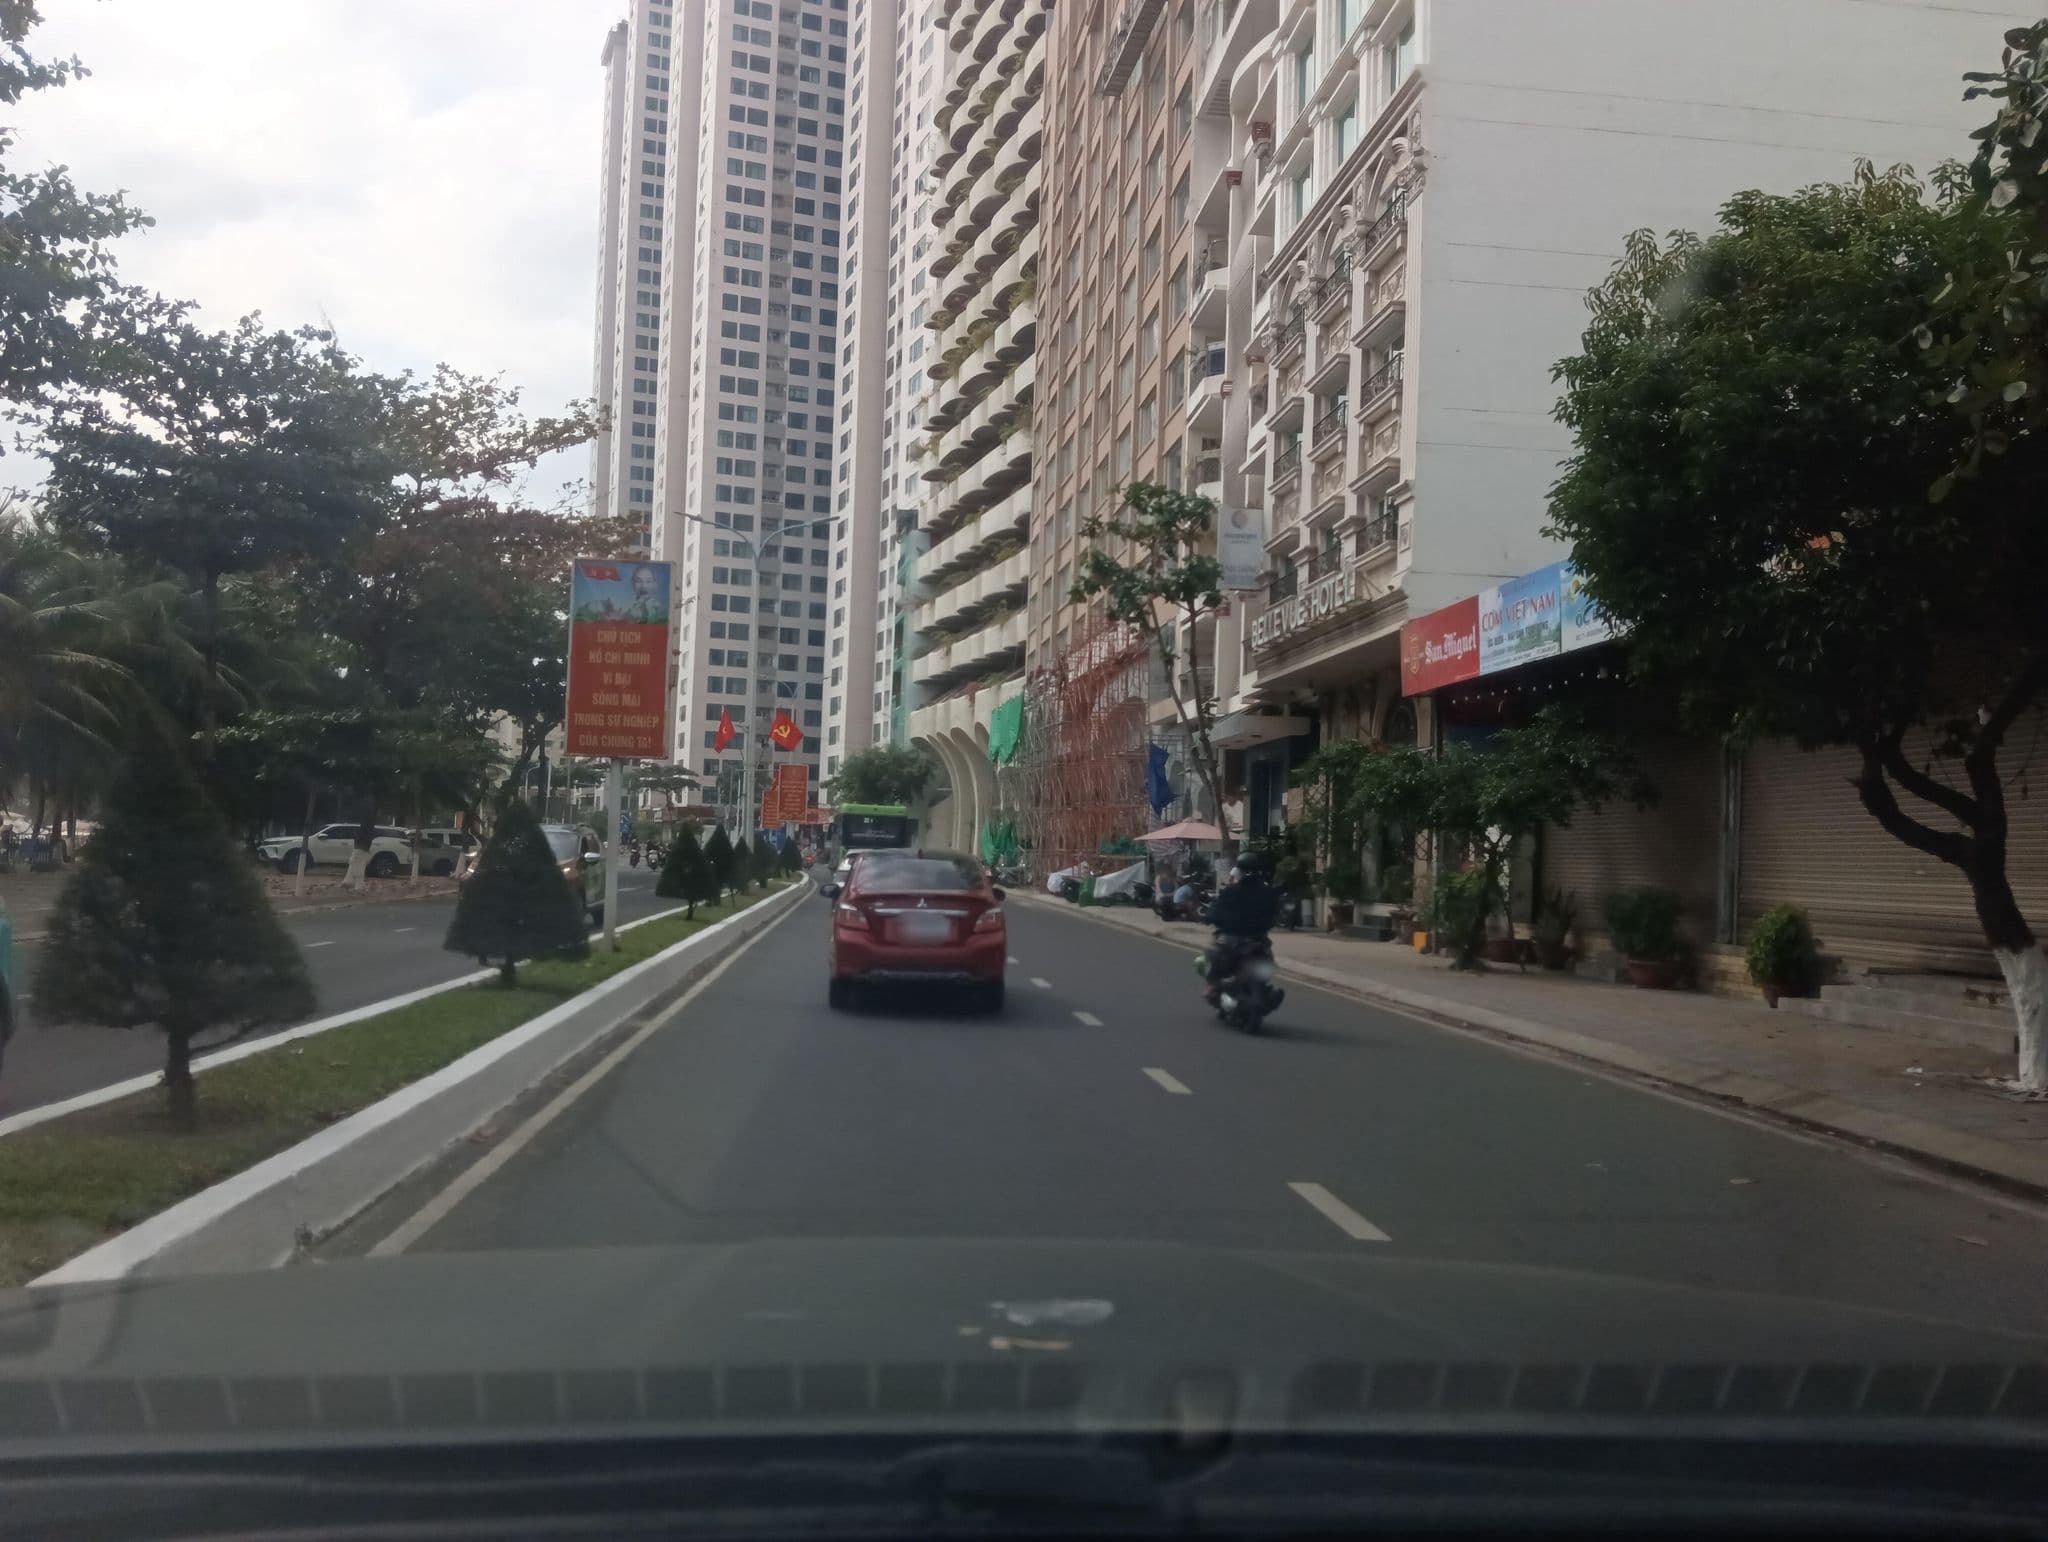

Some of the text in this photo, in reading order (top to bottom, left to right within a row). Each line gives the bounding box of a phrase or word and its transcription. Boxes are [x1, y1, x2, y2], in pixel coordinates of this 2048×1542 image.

[1252, 571, 1354, 648] BELLEVUE HOTEL
[1529, 590, 1556, 617] NAM
[623, 652, 650, 665] MINH
[1424, 639, 1443, 665] San
[1441, 623, 1477, 660] Miguel
